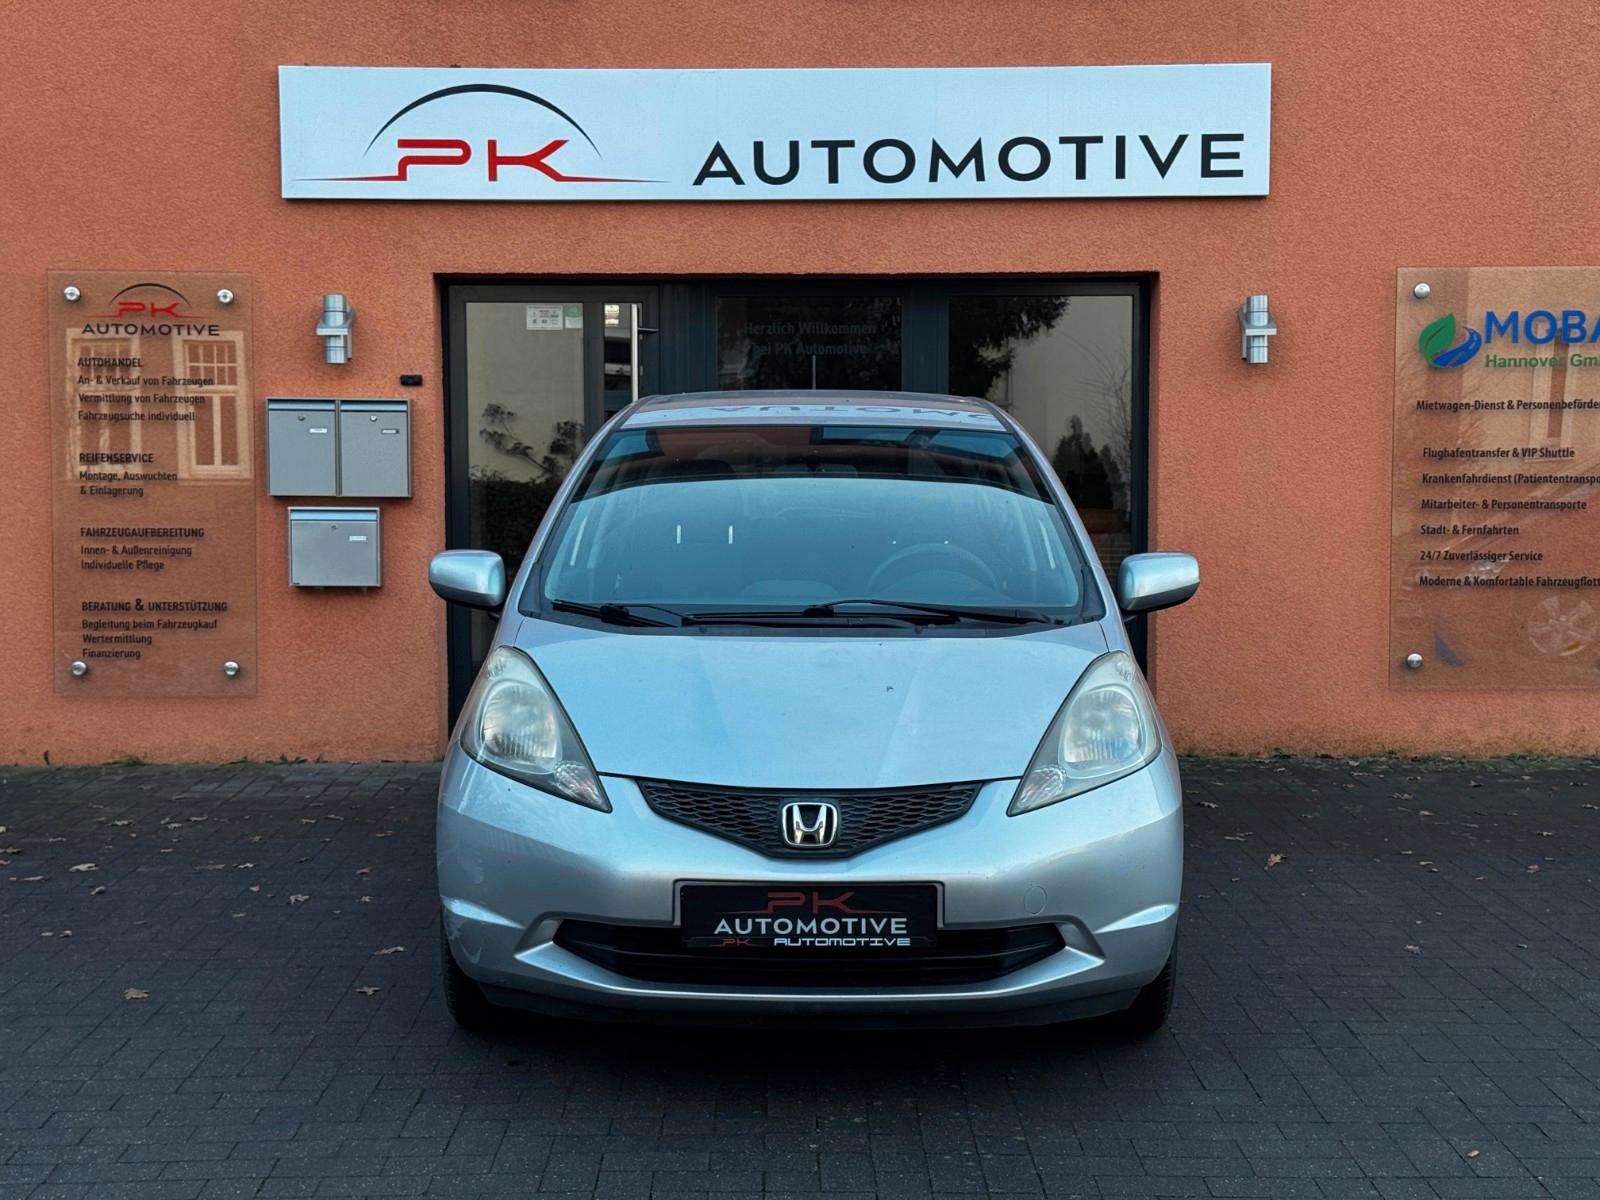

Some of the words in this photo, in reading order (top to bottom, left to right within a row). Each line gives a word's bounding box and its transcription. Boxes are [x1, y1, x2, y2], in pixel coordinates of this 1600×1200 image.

[397, 138, 569, 182] PK
[692, 131, 1245, 186] AUTOMOTIVE
[117, 302, 180, 319] PK
[81, 322, 221, 337] AUTOMOTIVE
[744, 321, 795, 336] Herzlich
[798, 321, 877, 336] Willkommen
[77, 357, 144, 369] AUTOHANDEL
[1484, 354, 1566, 369] Hannover
[1570, 353, 1600, 368] Gm
[77, 376, 94, 386] An-
[96, 376, 103, 386] &
[105, 375, 141, 386] Verkauf
[143, 377, 160, 386] von
[161, 376, 214, 389] Fahrzeugen
[78, 393, 133, 406] Vermittlung
[134, 395, 151, 404] von
[153, 394, 206, 406] Fahrzeugen
[1416, 399, 1505, 413] Mietwagen-Dienst
[1507, 400, 1515, 411] &
[1517, 398, 1600, 411] Personenbeförde
[78, 411, 146, 424] Fahrzeugsuche
[147, 411, 196, 422] individuell
[79, 453, 155, 464] REIFENSERVICE
[1423, 447, 1511, 461] Flughafentransfer
[1512, 448, 1520, 459] &
[1521, 448, 1538, 459] VIP
[1539, 447, 1576, 459] Shuttle
[79, 471, 121, 483] Montage,
[123, 471, 179, 482] Auswuchten
[1422, 473, 1512, 485] Krankenfahrdienst
[79, 486, 88, 496] &
[89, 486, 144, 498] Einlagerung
[1421, 499, 1480, 510] Mitarbeiter-
[1481, 500, 1489, 510] &
[1491, 499, 1587, 513] Personentransporte
[80, 527, 205, 538] FAHRZEUGAUFBEREITUNG
[1420, 525, 1450, 536] Stadt-
[1452, 525, 1460, 536] &
[1462, 525, 1520, 537] Fernfahrten
[80, 545, 110, 556] Innen-
[111, 545, 119, 555] &
[121, 545, 193, 558] Außenreinigung
[1419, 550, 1441, 562] 24/7
[1443, 550, 1508, 563] Zuverlässiger
[1508, 550, 1544, 562] Service
[80, 560, 134, 571] Individuelle
[136, 559, 165, 573] Pflege
[1419, 575, 1462, 587] Moderne
[1463, 576, 1472, 587] &
[1473, 576, 1535, 588] Komfortable
[81, 601, 132, 612] BERATUNG
[135, 598, 145, 612] &
[147, 599, 228, 612] UNTERSTÜTZUNG
[81, 619, 130, 632] Begleitung
[132, 619, 155, 630] beim
[157, 619, 218, 632] Fahrzeugkauf
[82, 633, 153, 646] Wertermittlung
[82, 648, 142, 661] Finanzierung
[766, 891, 856, 915] PK
[713, 917, 908, 936] AUTOMOTIVE
[773, 936, 912, 947] AUTOMOTIVE
